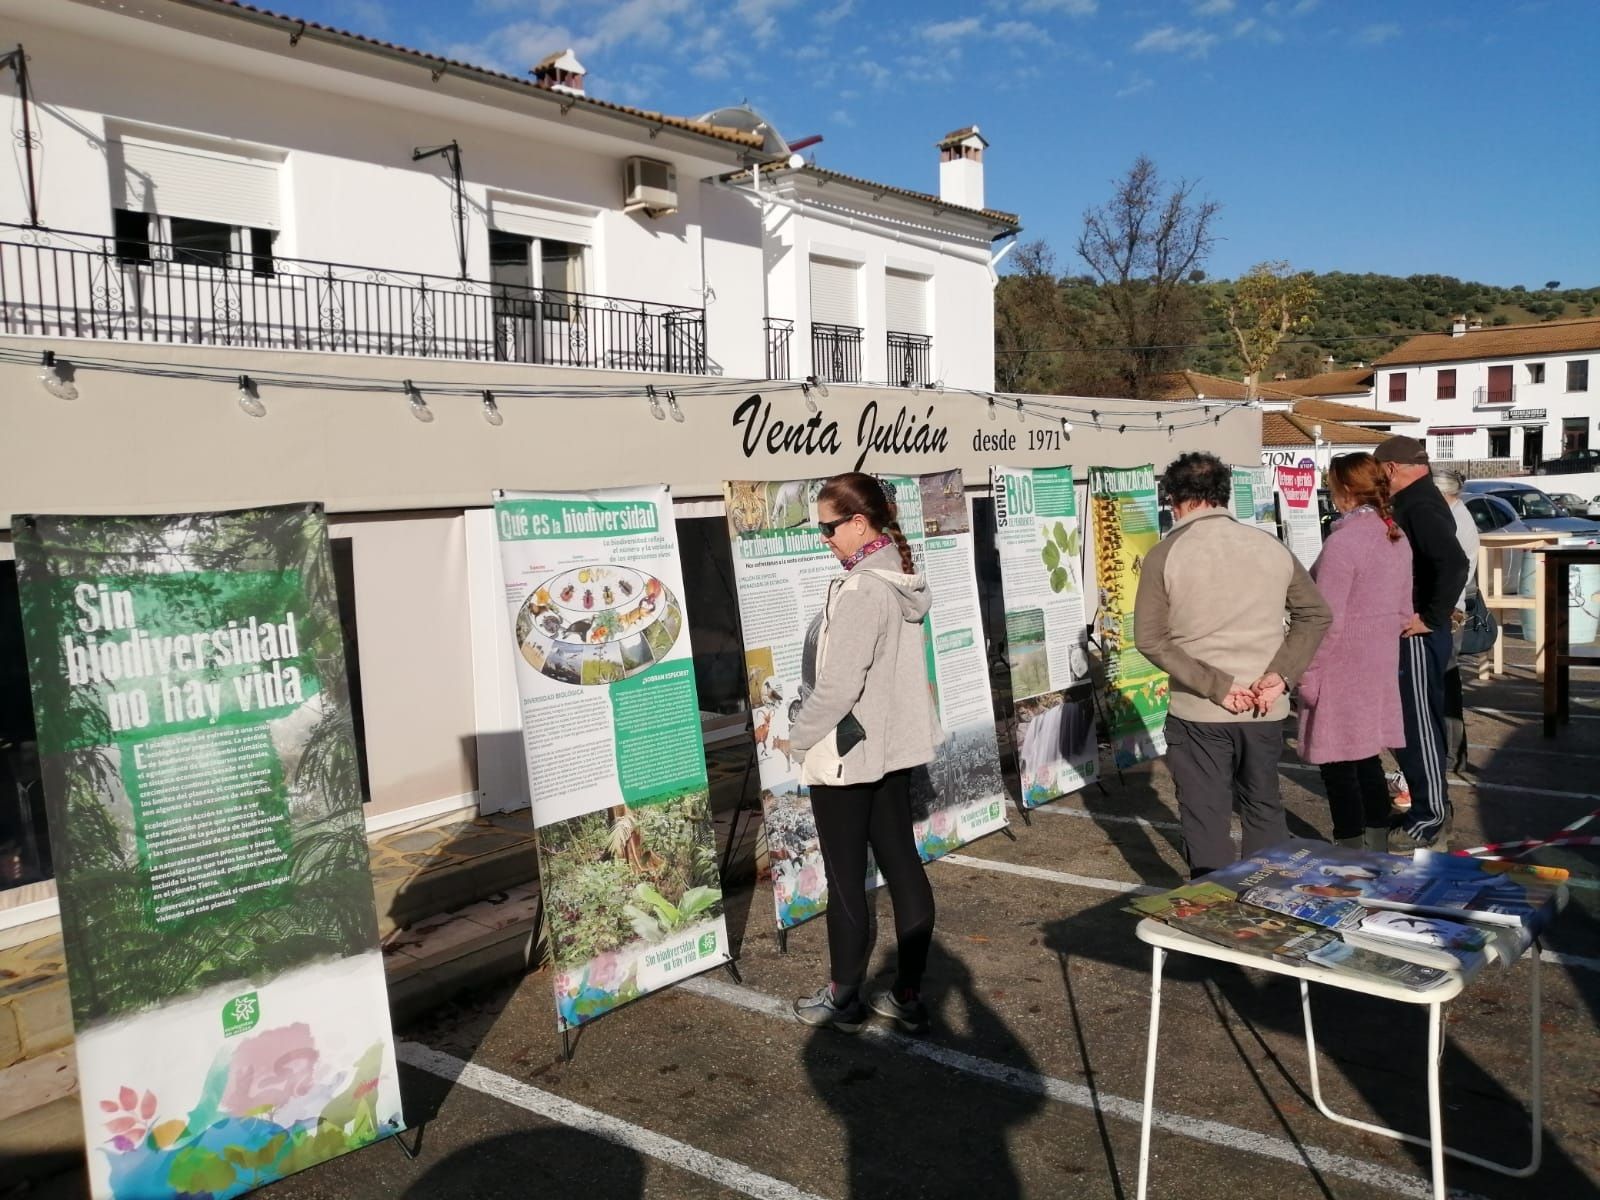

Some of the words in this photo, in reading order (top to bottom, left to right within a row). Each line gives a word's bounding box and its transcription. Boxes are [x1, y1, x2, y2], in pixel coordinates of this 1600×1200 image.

[732, 394, 841, 458] Venta
[854, 400, 948, 472] Julián
[973, 428, 1016, 451] desde
[1028, 429, 1060, 451] 1971
[1091, 471, 1102, 494] LA
[1006, 474, 1033, 516] BIO
[500, 508, 528, 538] Qué
[532, 514, 550, 535] es
[552, 518, 560, 534] la
[562, 503, 656, 534] biodiversidad
[736, 532, 784, 558] Perdiendo
[785, 529, 831, 554] biodiver
[74, 583, 136, 632] Sin
[64, 612, 299, 686] biodiversidad
[108, 688, 150, 731] no
[160, 676, 223, 724] hay
[233, 661, 303, 712] vida
[141, 799, 151, 807] los
[144, 816, 182, 830] Ecologistas
[146, 830, 160, 839] esta
[198, 819, 212, 830] para
[214, 816, 225, 826] que
[147, 833, 186, 849] importancia
[153, 848, 163, 856] las
[160, 855, 195, 869] naturaleza
[187, 864, 200, 874] para
[152, 877, 179, 890] incluida
[171, 883, 196, 897] planeta
[196, 902, 209, 912] este
[645, 954, 656, 968] Sin
[657, 938, 696, 962] biodiversidad
